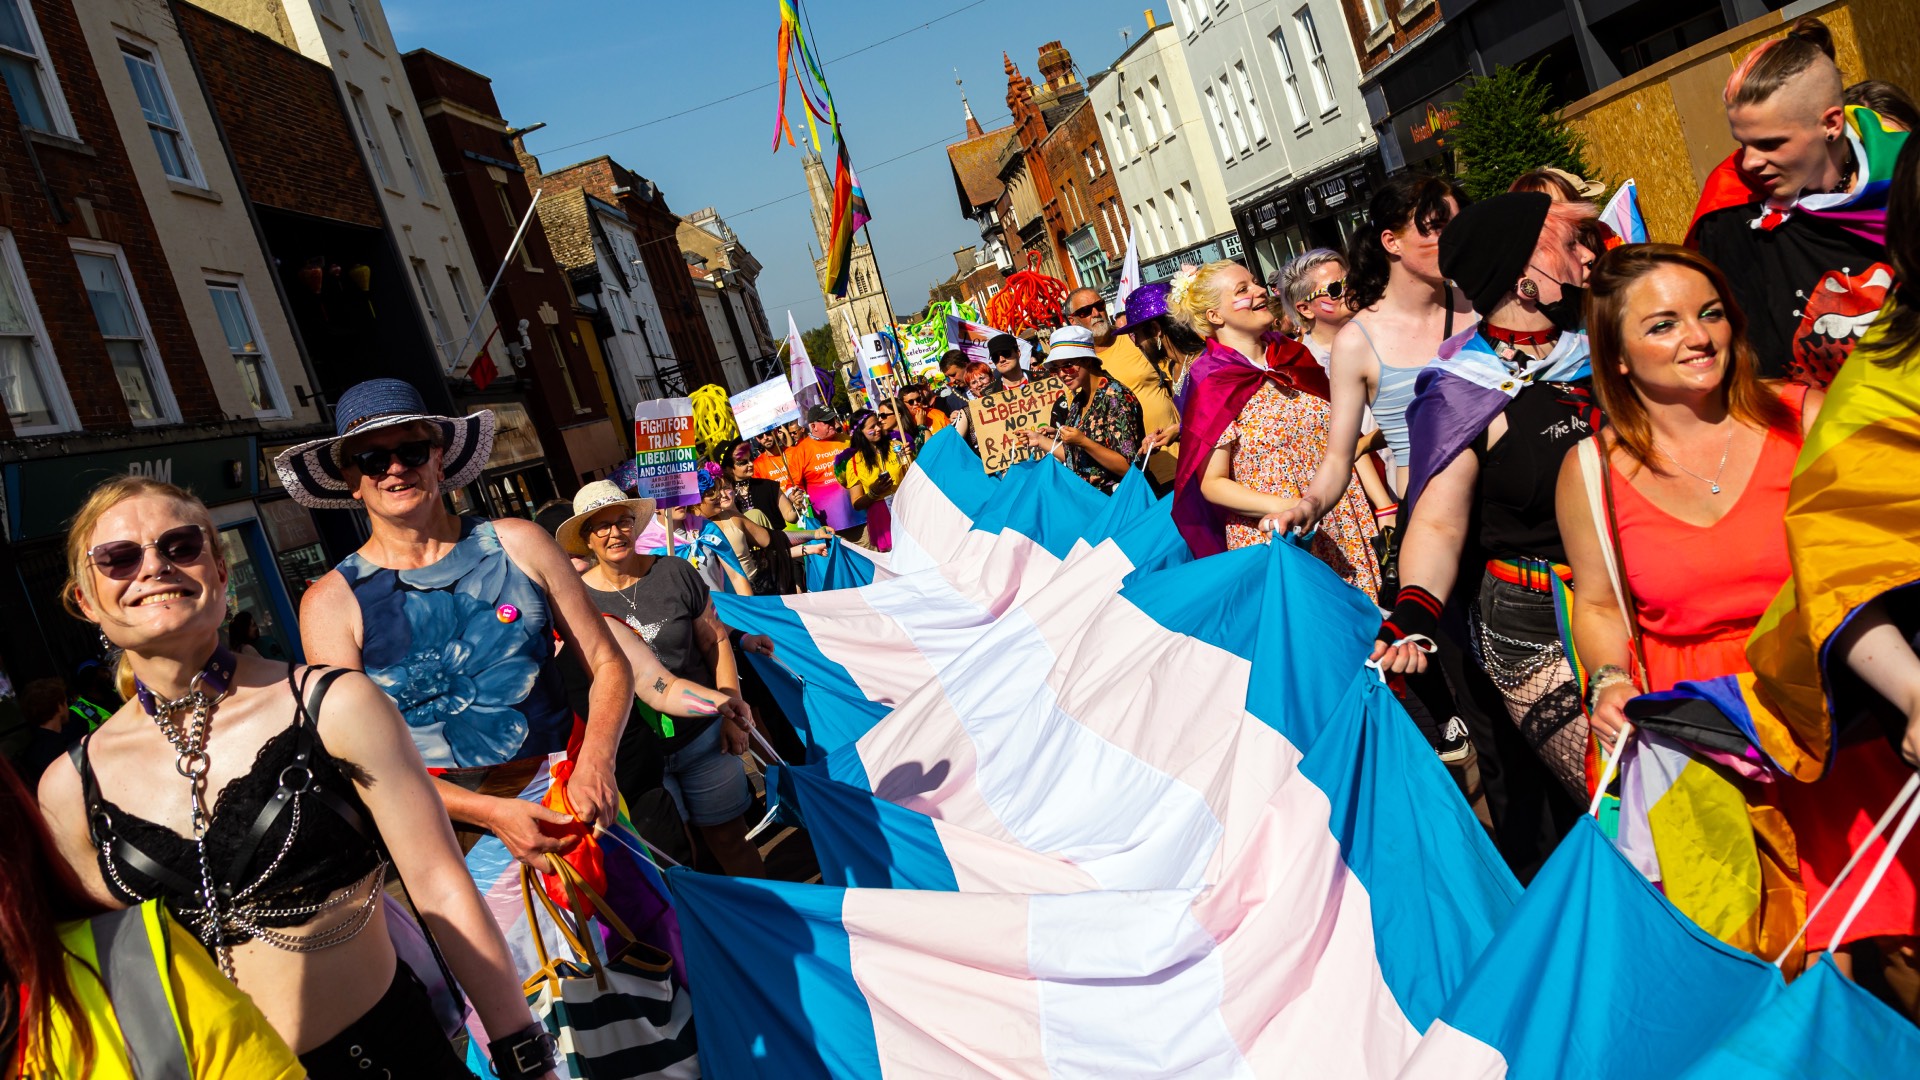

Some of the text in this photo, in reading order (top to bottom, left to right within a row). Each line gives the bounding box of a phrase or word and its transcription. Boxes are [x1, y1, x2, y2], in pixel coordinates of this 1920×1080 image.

[873, 339, 883, 352] B
[909, 359, 923, 368] and
[640, 417, 689, 435] FIGHT FOR
[1005, 409, 1042, 432] NOT
[1540, 420, 1570, 443] The
[648, 432, 682, 449] TRANS
[640, 448, 693, 465] LIBERATION
[640, 462, 695, 477] AND SOCIALISM
